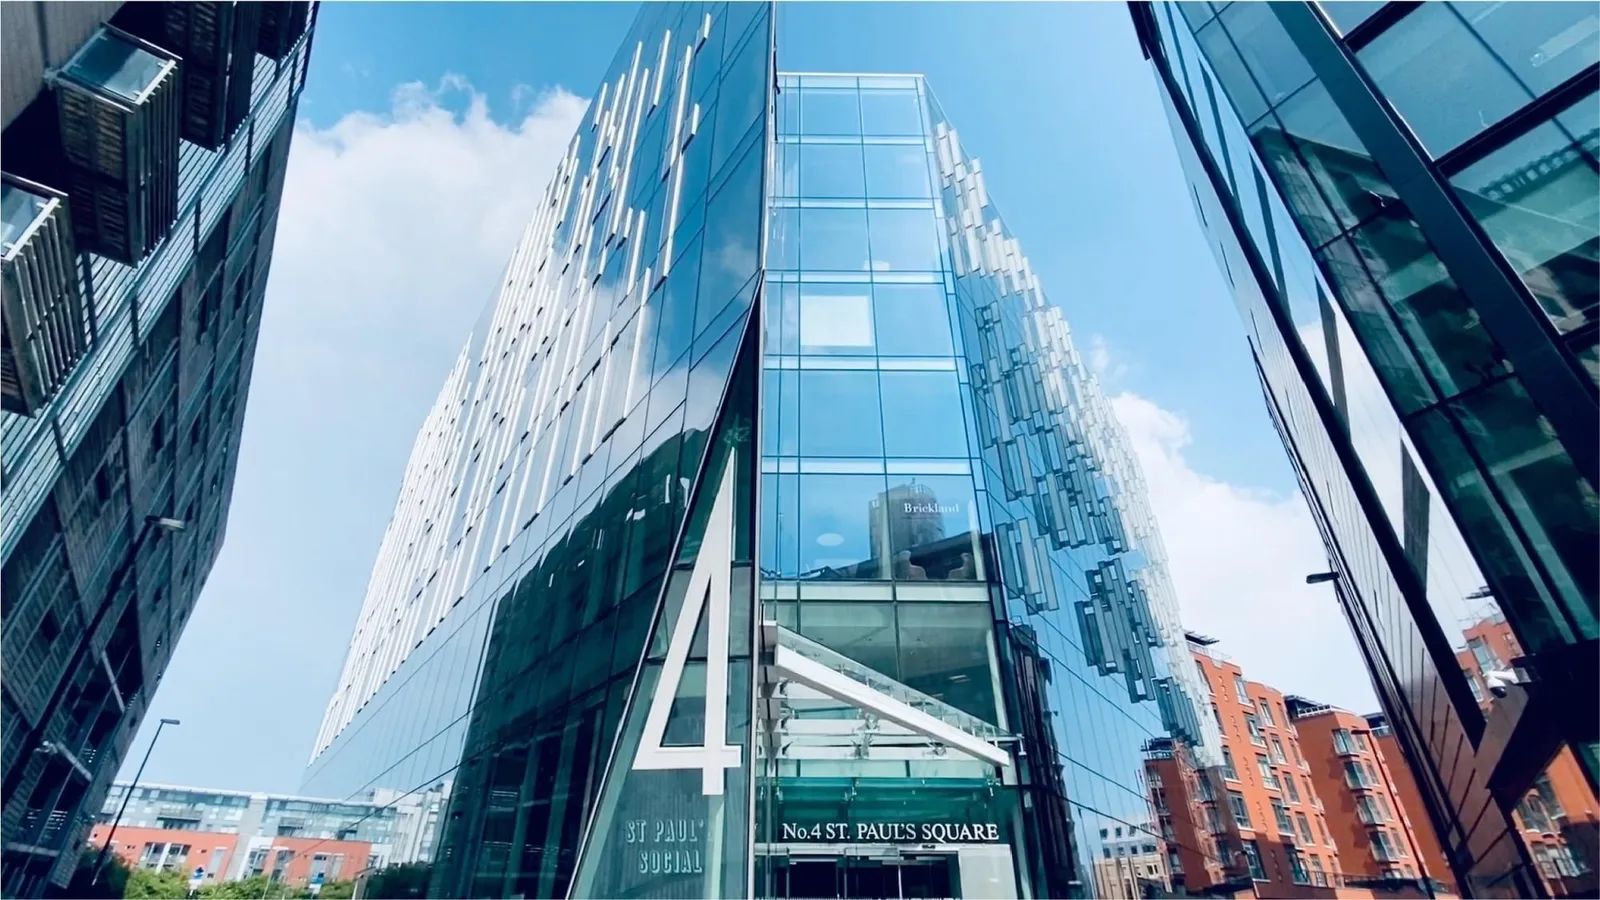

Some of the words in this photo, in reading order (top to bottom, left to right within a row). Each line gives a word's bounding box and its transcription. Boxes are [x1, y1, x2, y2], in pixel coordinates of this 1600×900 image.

[903, 502, 960, 513] Brickland
[632, 446, 742, 795] 4
[625, 819, 647, 843] ST
[654, 819, 712, 842] PAUL'
[782, 823, 821, 840] No.4
[826, 823, 850, 840] ST.
[857, 823, 916, 840] PAUL'S
[921, 823, 1000, 843] SQUARE
[639, 850, 703, 873] SOCIAL
